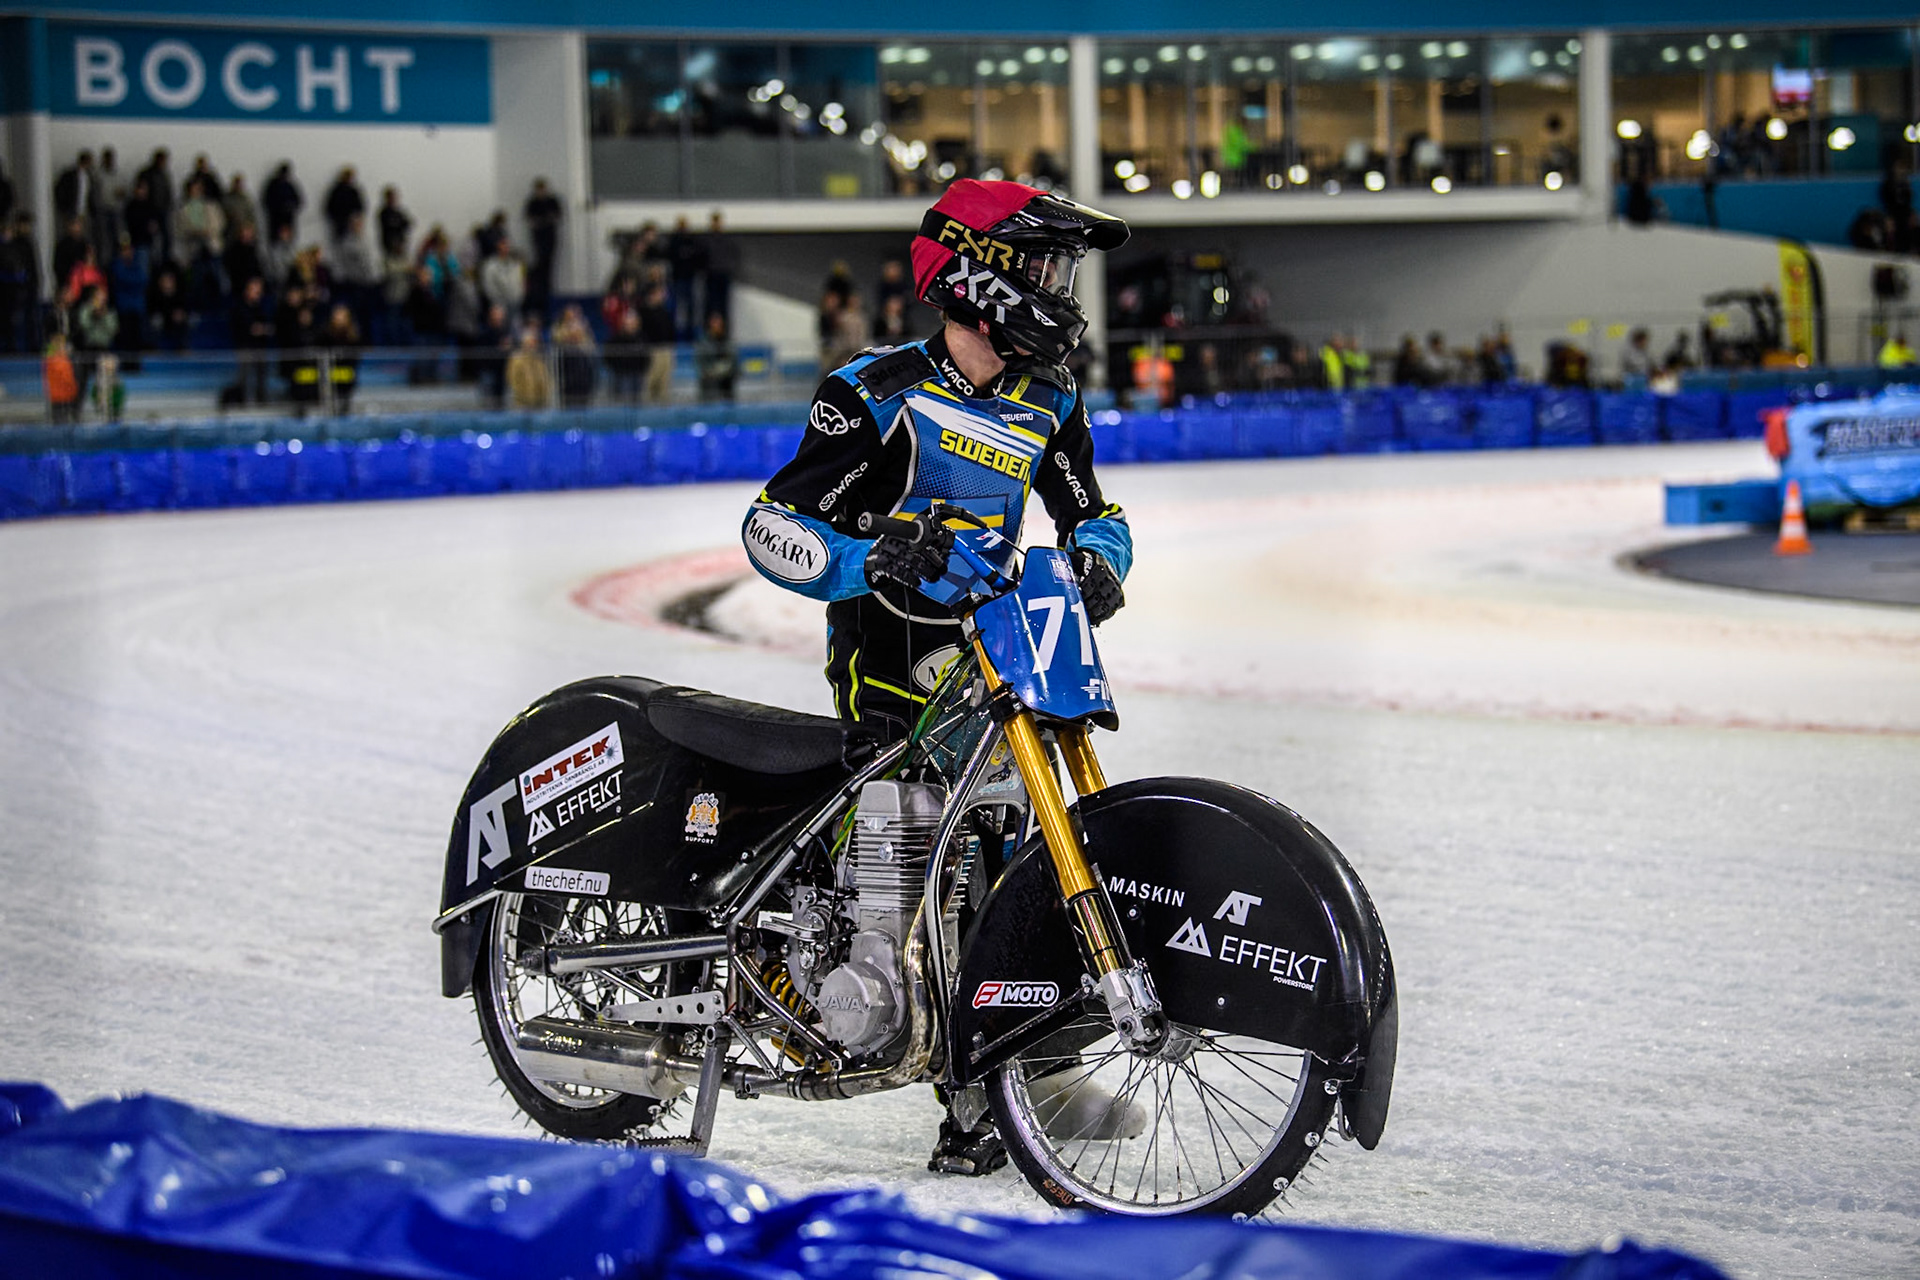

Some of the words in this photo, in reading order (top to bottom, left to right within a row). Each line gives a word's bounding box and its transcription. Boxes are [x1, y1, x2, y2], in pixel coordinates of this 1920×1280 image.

[73, 35, 415, 113] BOCHT
[938, 220, 1014, 271] FXR
[946, 255, 1023, 324] XR
[941, 358, 974, 396] WACO
[939, 428, 1031, 482] SWEDEN
[832, 462, 868, 495] WACO
[1065, 468, 1089, 508] WACO
[747, 518, 818, 570] MOGÅRN
[1027, 596, 1094, 675] 71
[556, 770, 623, 827] EFFEKT
[532, 869, 602, 893] thechef.nu
[1109, 876, 1185, 908] MASKIN
[1219, 935, 1328, 983] EFFEKT
[821, 995, 864, 1011] JAWA
[1003, 986, 1056, 1002] MOTO
[1273, 976, 1315, 992] POWERSTORE
